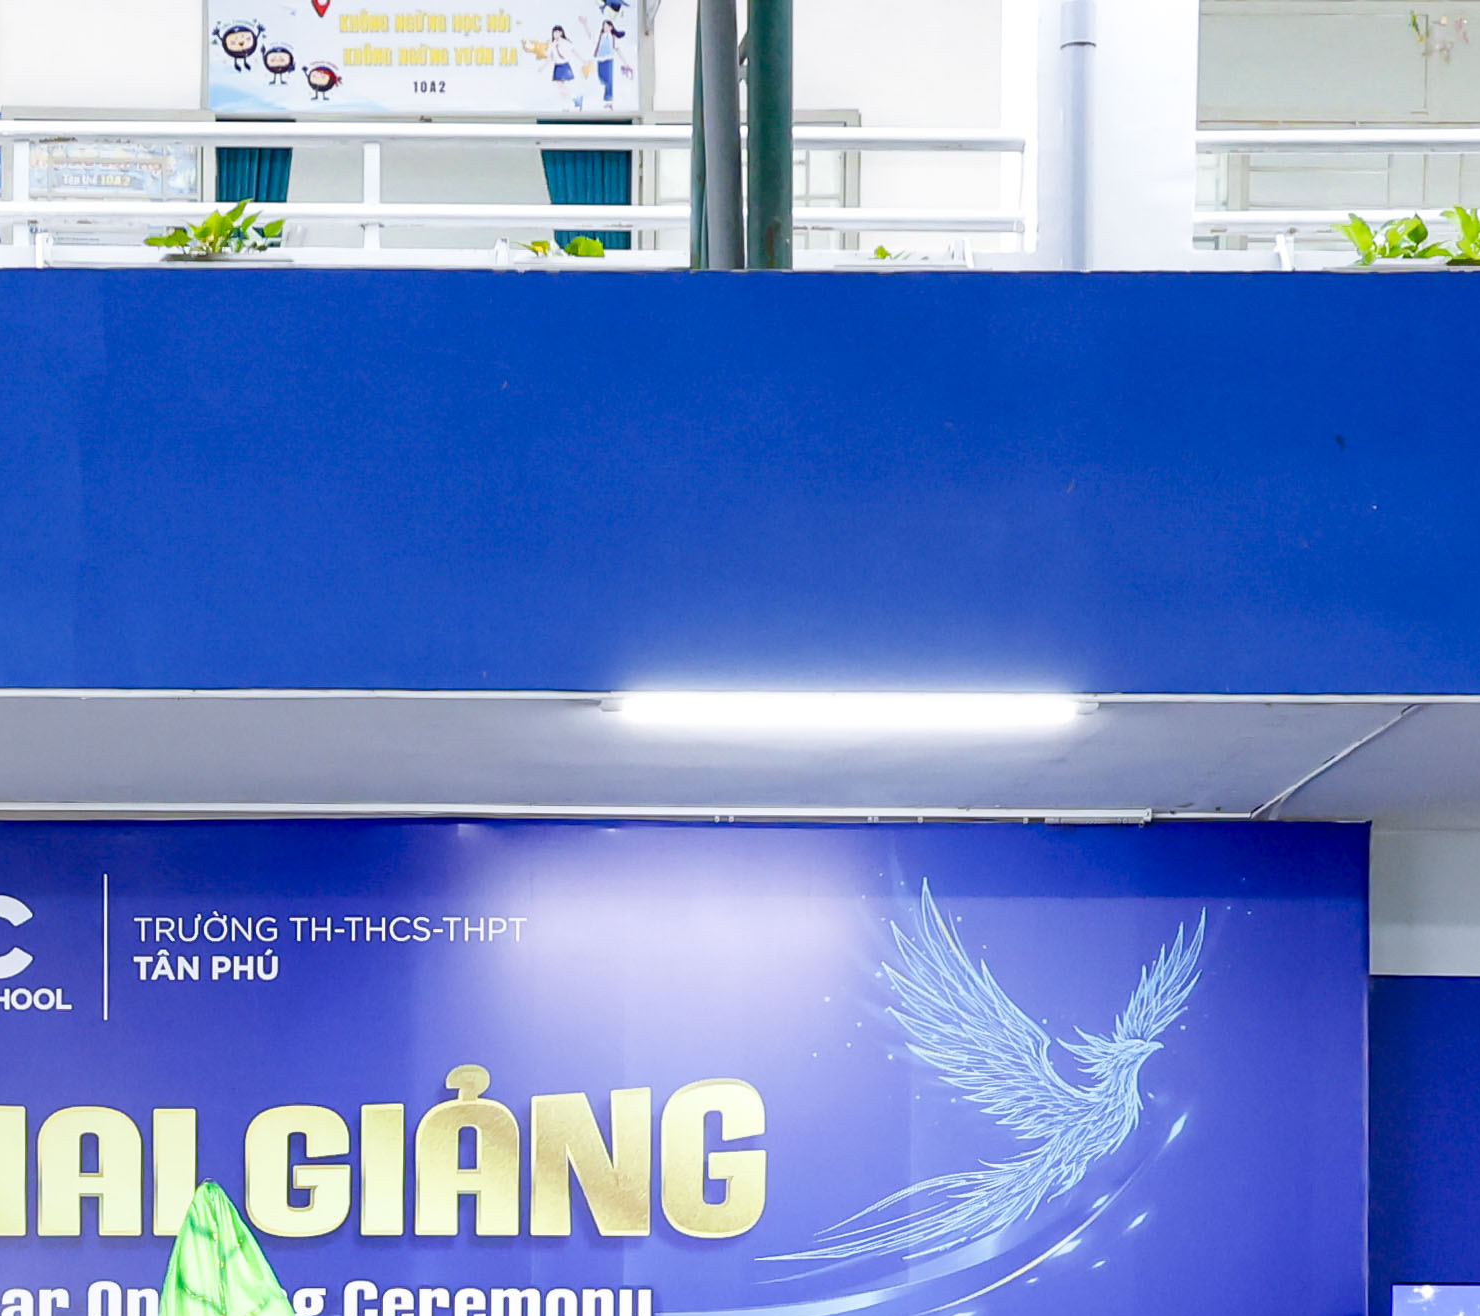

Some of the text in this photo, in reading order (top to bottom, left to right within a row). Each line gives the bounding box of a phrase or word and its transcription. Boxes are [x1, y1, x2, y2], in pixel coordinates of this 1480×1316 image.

[413, 80, 447, 93] 10A2
[134, 911, 528, 943] TRƯỜNG TH-THCS-THPT
[134, 949, 280, 982] TÂN PHÚ
[244, 1064, 768, 1239] GIẢNG
